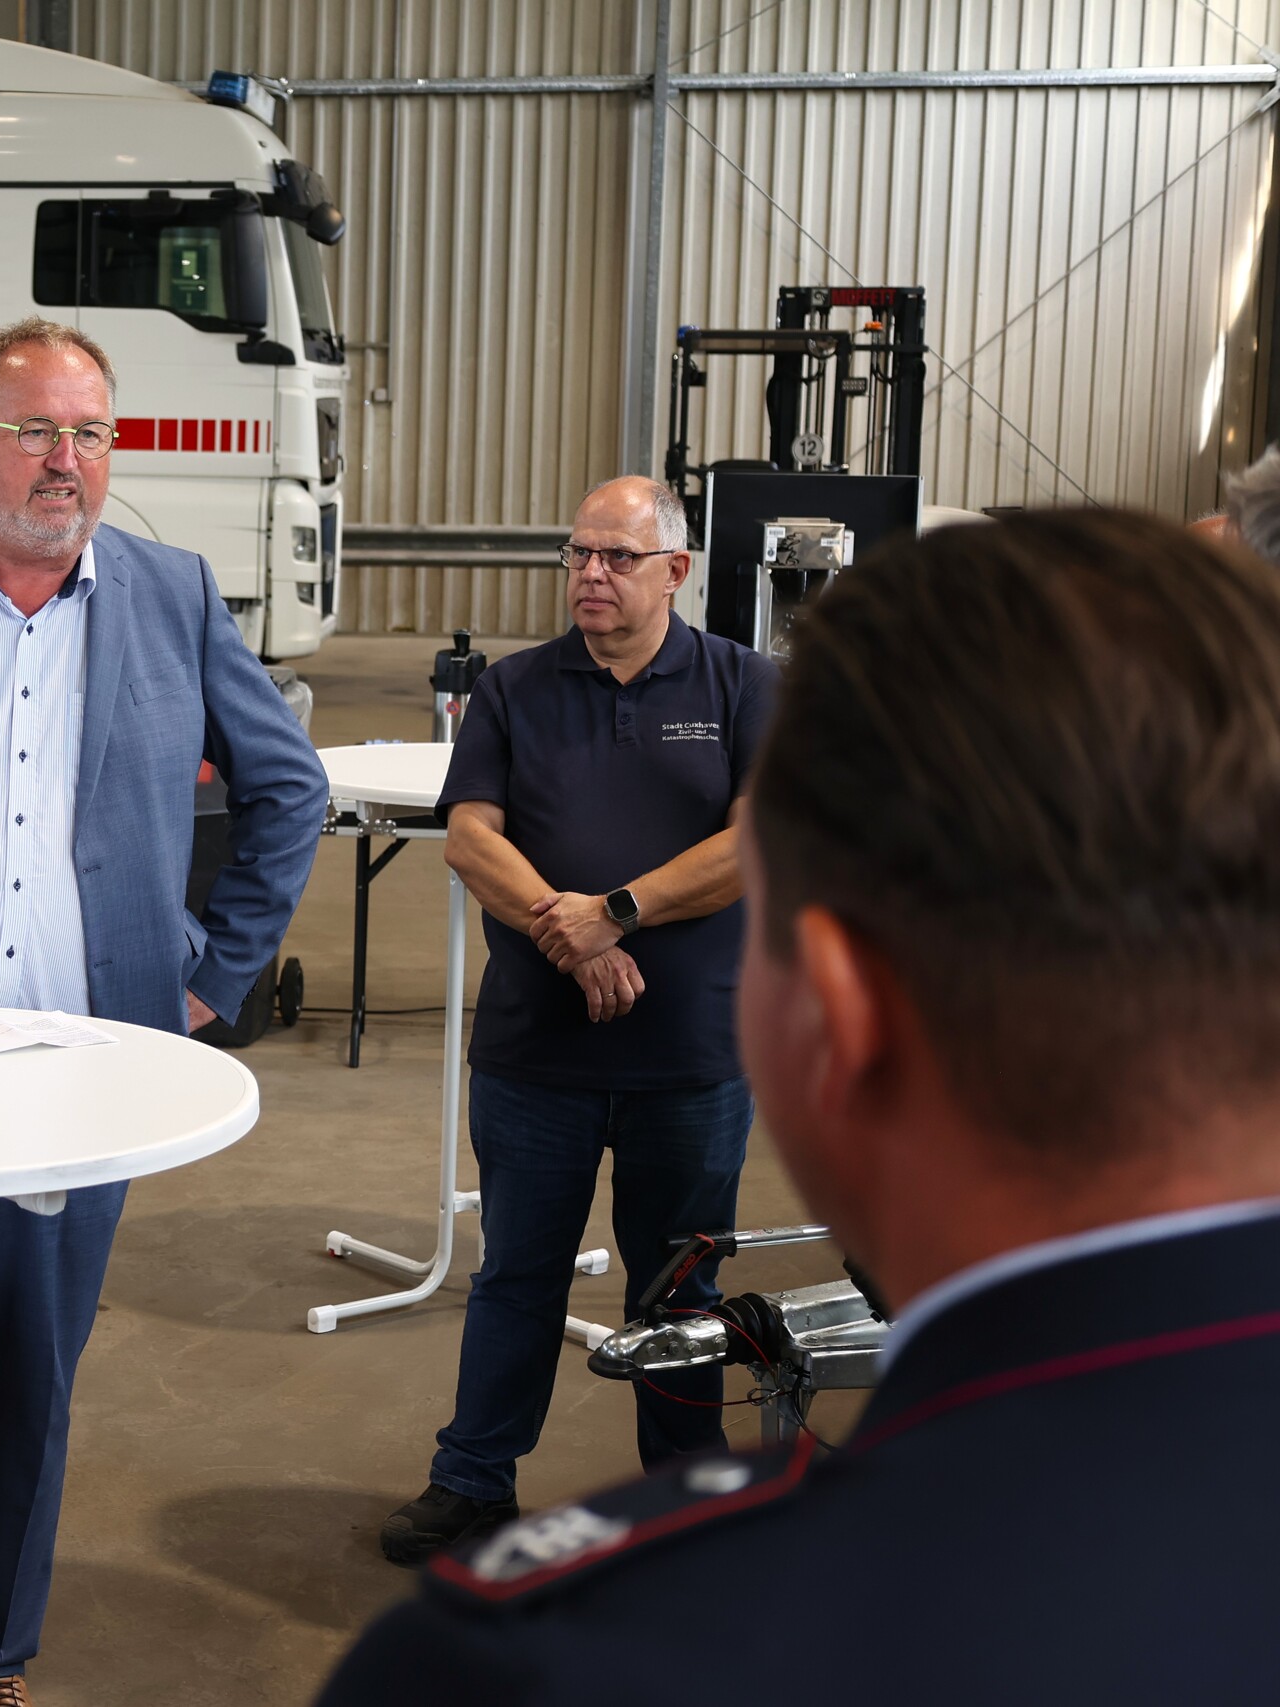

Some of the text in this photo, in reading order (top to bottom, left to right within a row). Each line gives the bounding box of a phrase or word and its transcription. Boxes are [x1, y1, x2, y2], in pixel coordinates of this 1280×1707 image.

[831, 288, 897, 305] MOFFETT
[800, 440, 817, 456] 12
[661, 722, 683, 731] Stadt
[661, 733, 720, 742] Katastrophenschu
